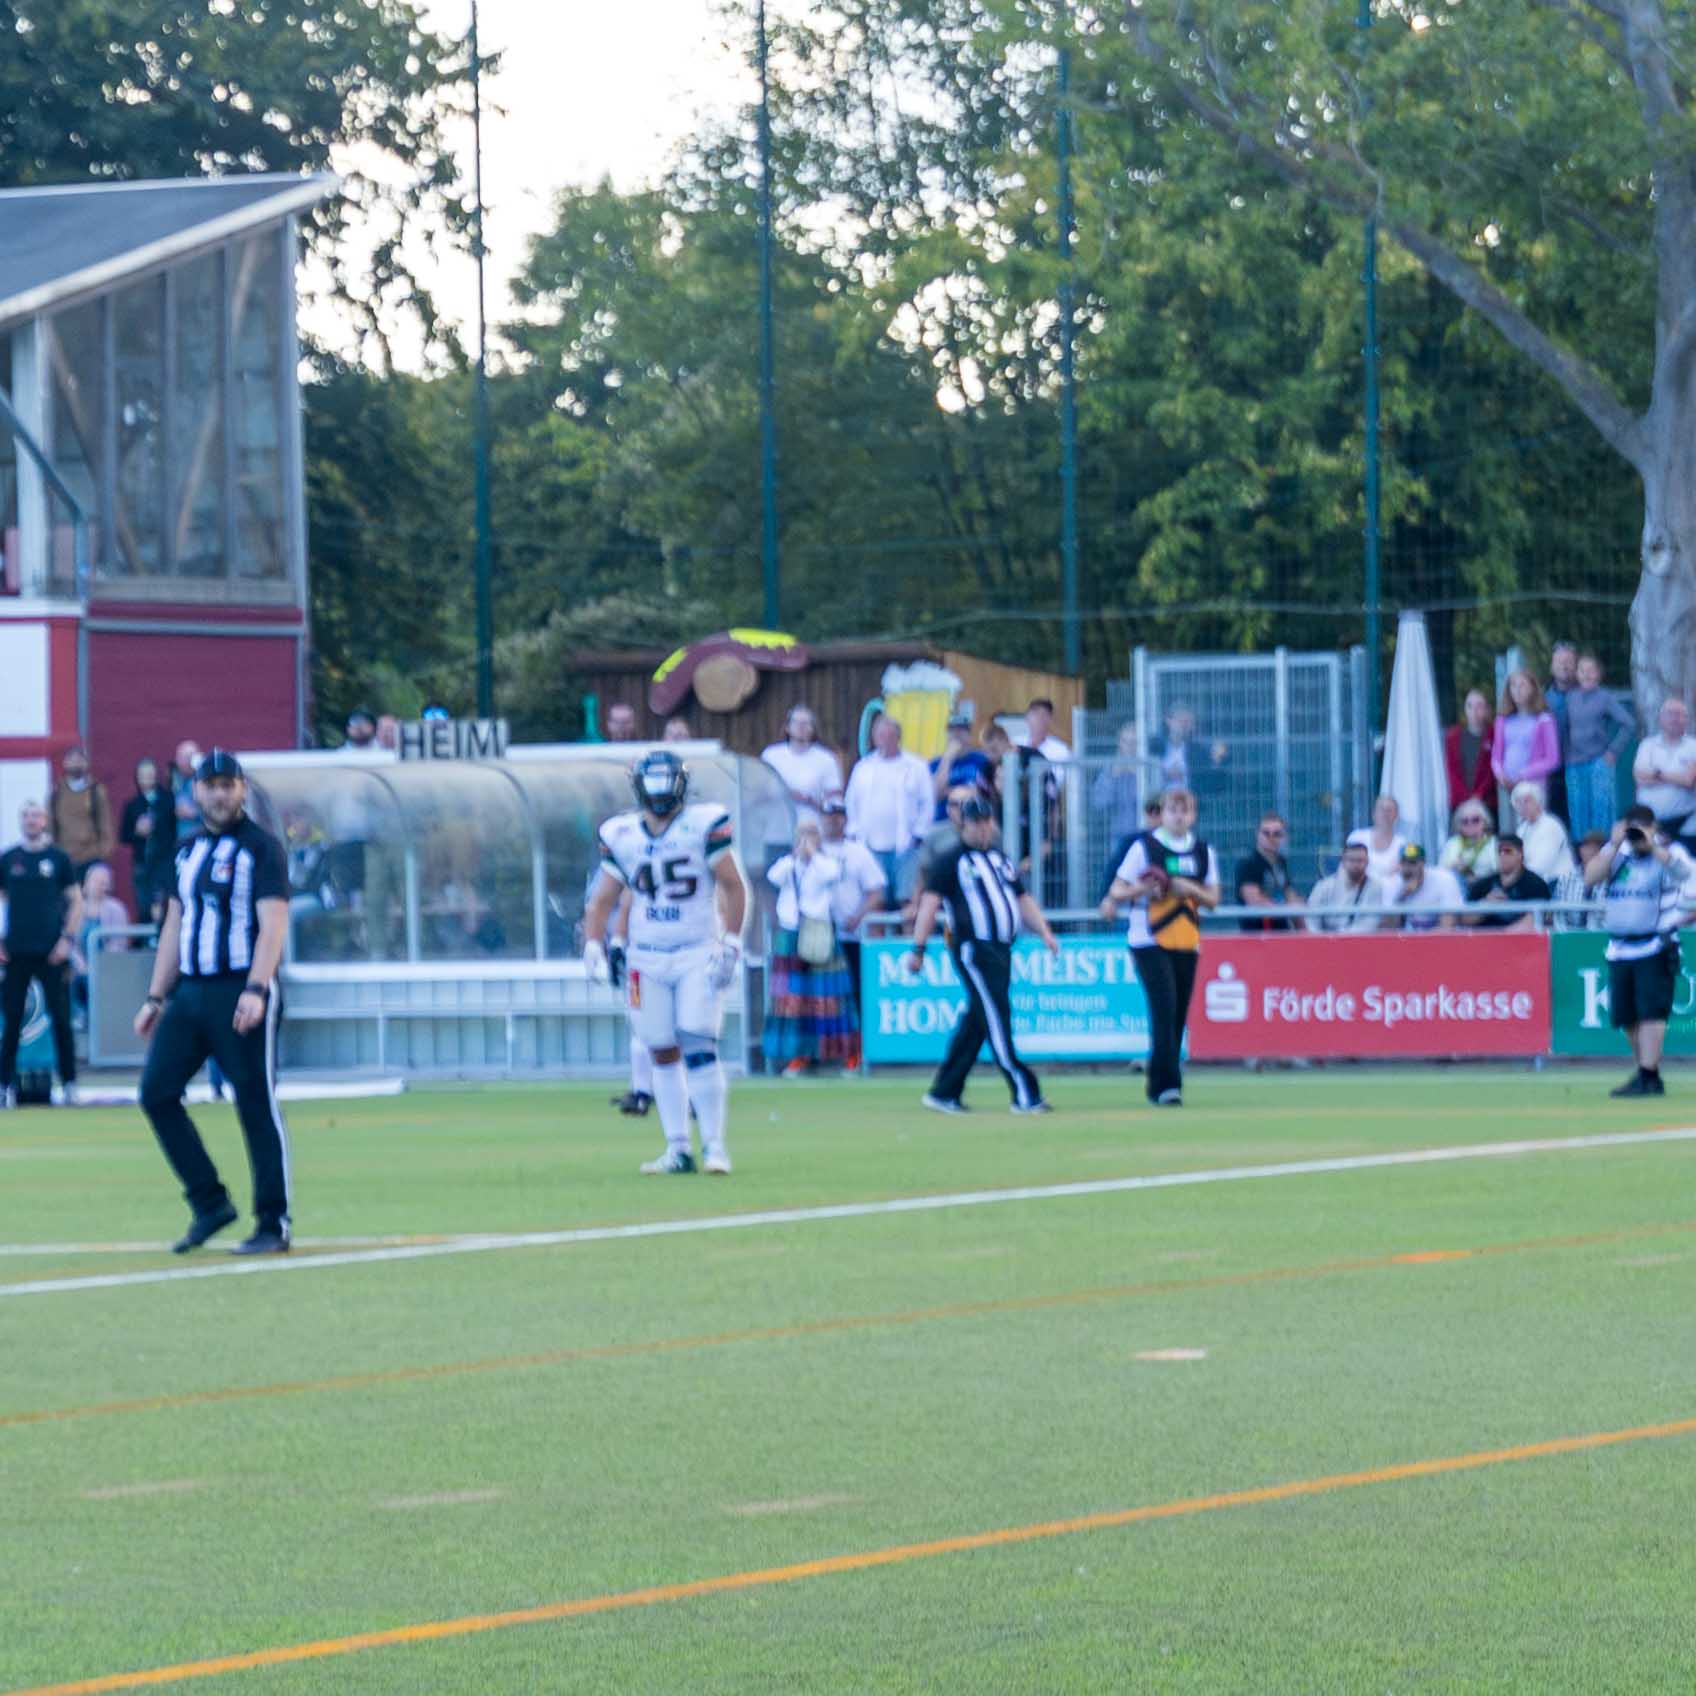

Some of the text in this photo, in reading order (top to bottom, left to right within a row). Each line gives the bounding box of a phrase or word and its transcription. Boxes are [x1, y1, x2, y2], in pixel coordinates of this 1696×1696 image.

[399, 719, 502, 761] HEIM
[632, 857, 698, 900] 45
[1263, 984, 1355, 1022] Förde
[1363, 984, 1533, 1029] Sparkasse
